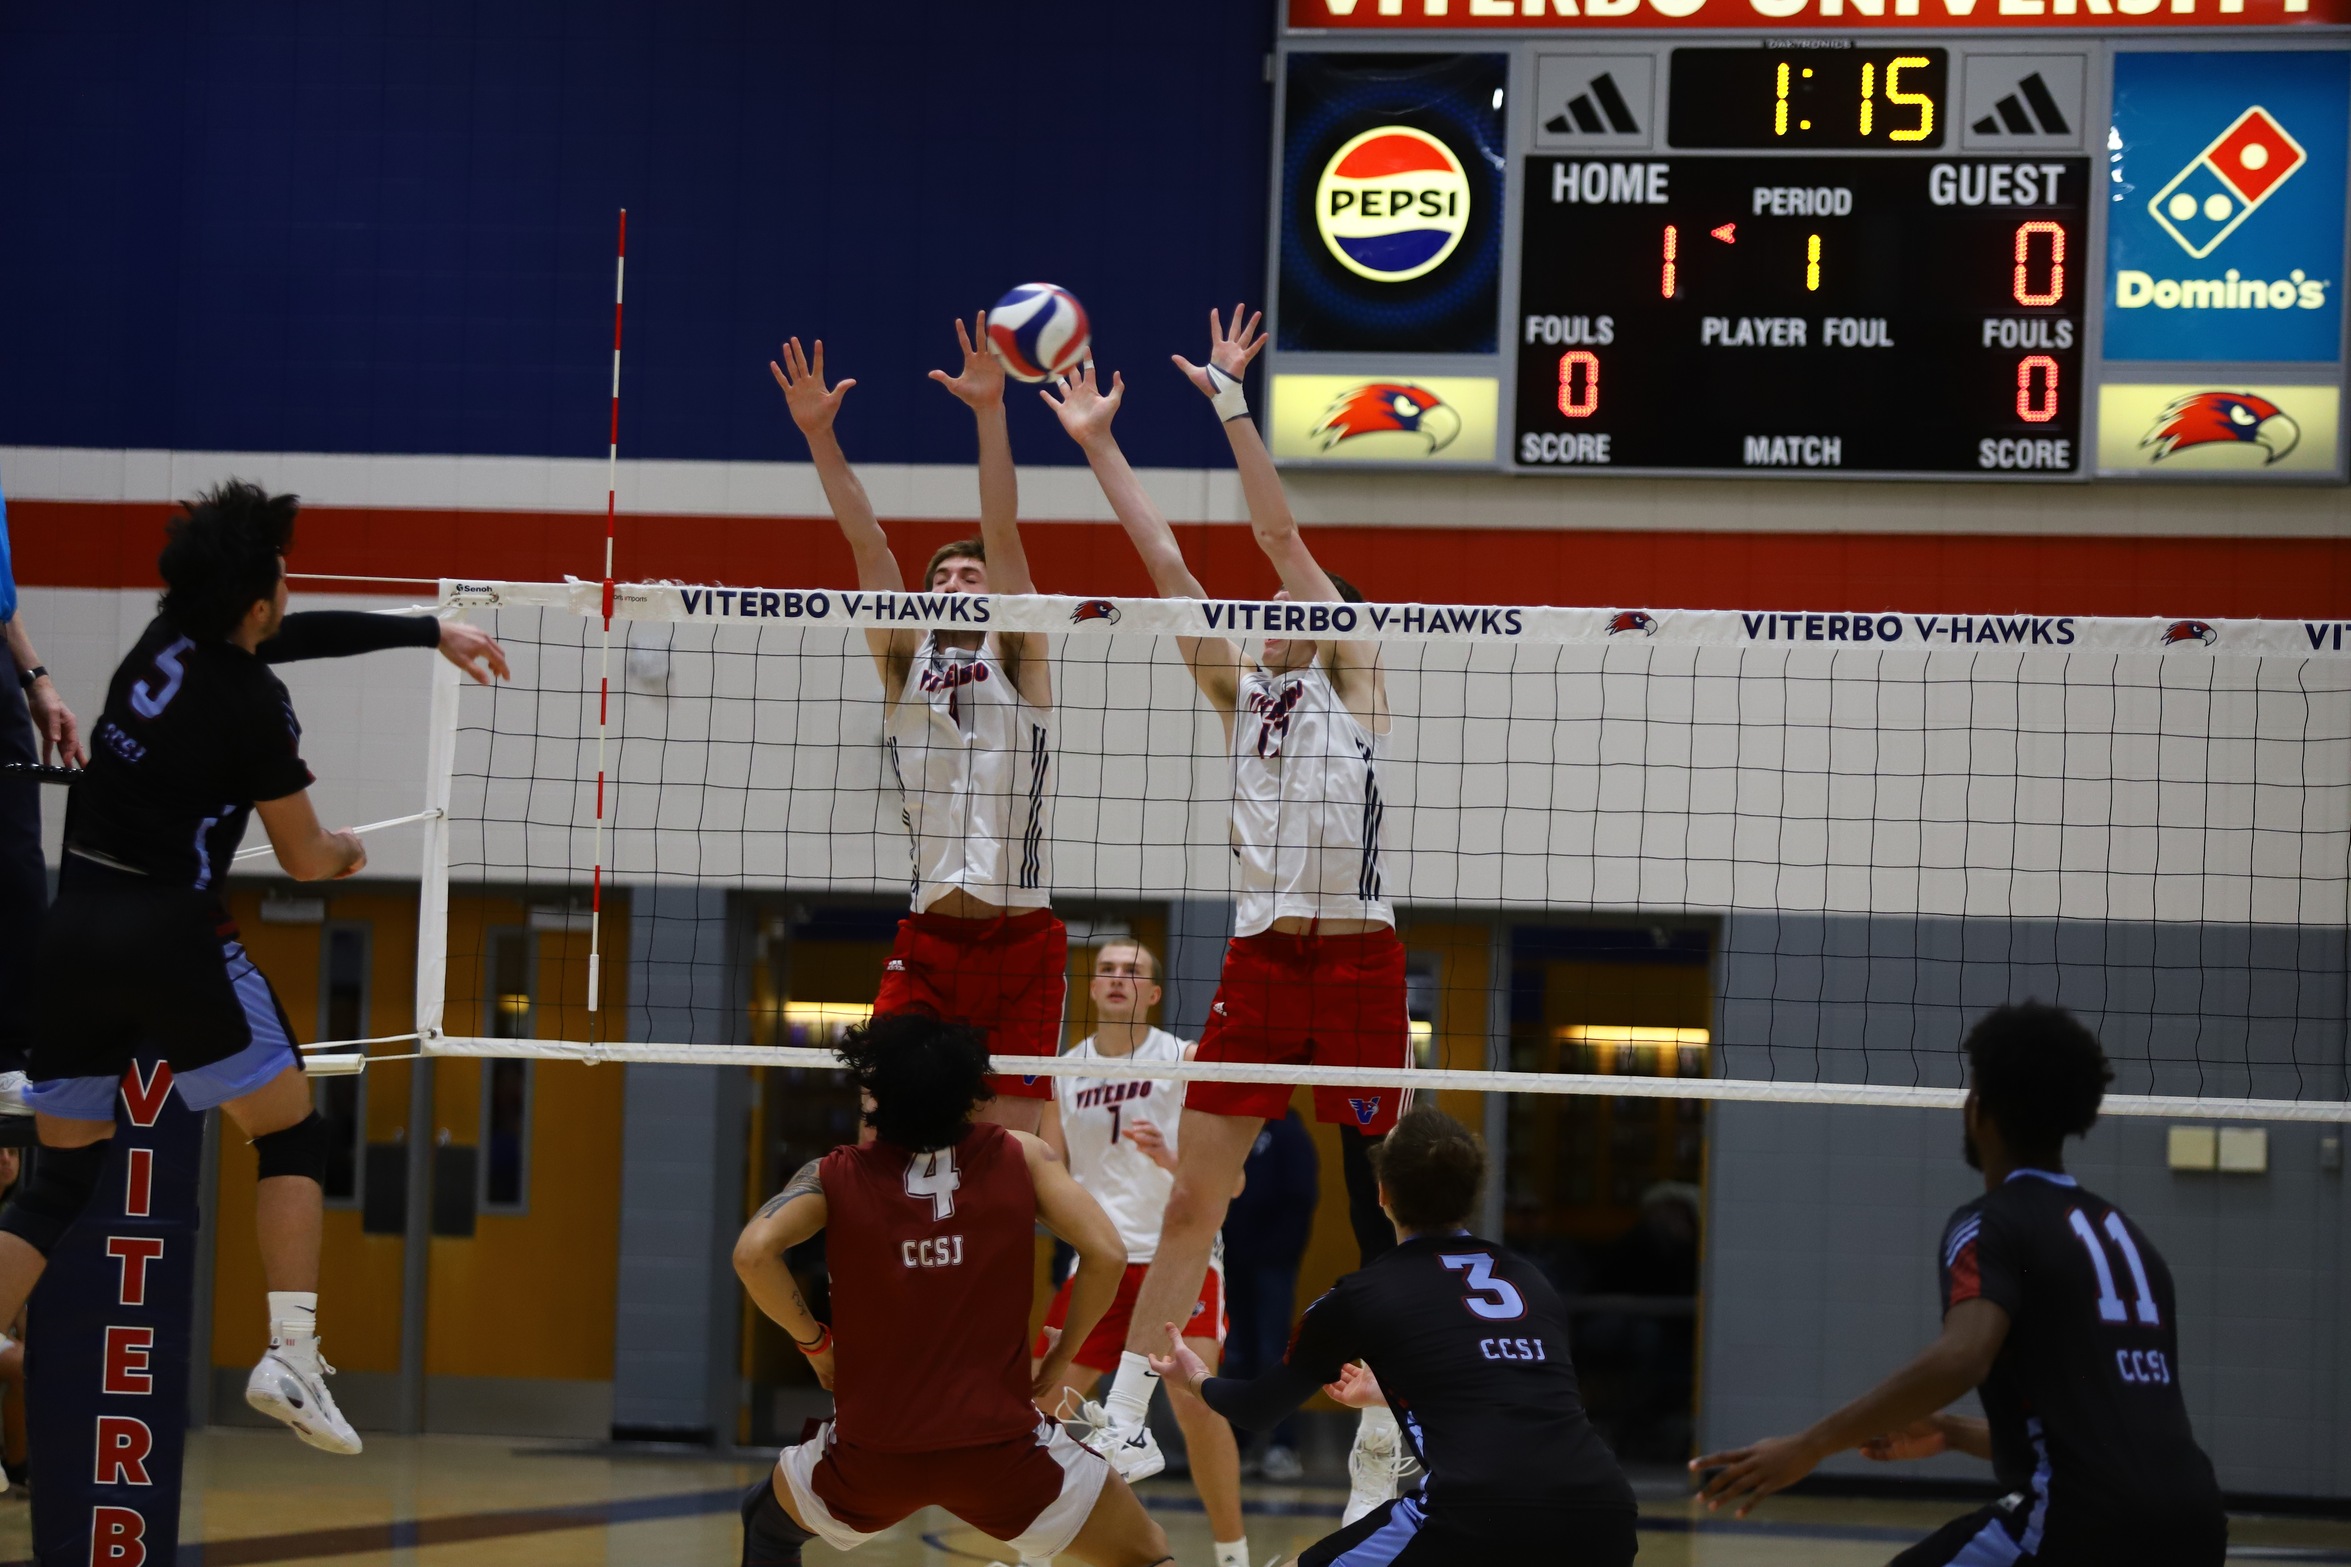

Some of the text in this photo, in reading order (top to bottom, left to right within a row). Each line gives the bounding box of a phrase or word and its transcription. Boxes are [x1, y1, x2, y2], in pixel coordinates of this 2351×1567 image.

[1552, 163, 1670, 204] HOME
[1929, 164, 2066, 206] GUEST
[1331, 190, 1457, 218] PEPSI
[1753, 187, 1853, 216] PERIOD
[1661, 225, 1678, 299] 1
[1806, 234, 1822, 291] 1
[2013, 221, 2065, 306] 0
[2115, 268, 2326, 310] Domino's
[1526, 315, 1614, 345] FOULS
[1702, 317, 1894, 347] PLAYER FOUL
[1983, 318, 2073, 349] FOULS
[1558, 351, 1599, 418] 0
[2016, 356, 2058, 422] 0
[1522, 433, 1611, 463] SCORE
[1744, 436, 1842, 466] MATCH
[1979, 438, 2070, 469] SCORE
[464, 585, 493, 593] Senoh
[679, 588, 991, 623] VITERBO V-HAWKS
[1201, 602, 1523, 636] VITERBO V-HAWKS
[1741, 612, 2076, 645] VITERBO V-HAWKS
[131, 633, 197, 719] 5
[903, 1144, 961, 1221] 4
[902, 1235, 963, 1269] CCSJ
[2066, 1206, 2162, 1327] 11
[1437, 1250, 1527, 1321] 3
[1479, 1337, 1547, 1361] CCSJ
[2116, 1349, 2171, 1385] CCSJ
